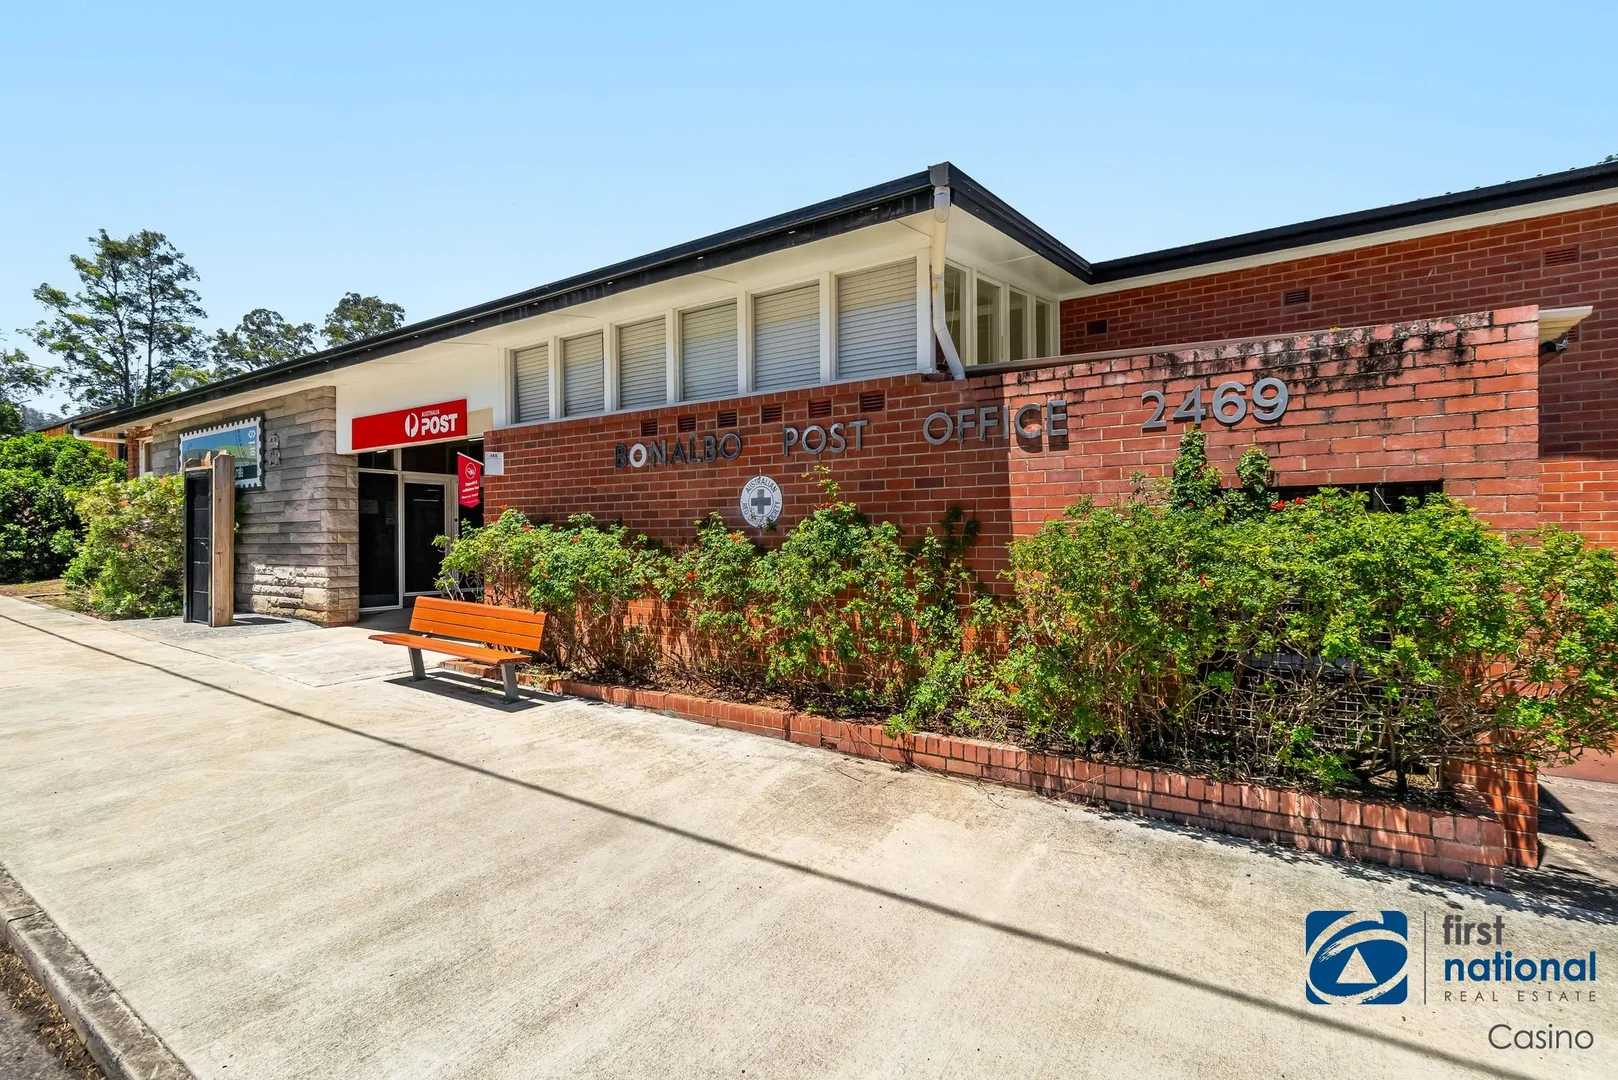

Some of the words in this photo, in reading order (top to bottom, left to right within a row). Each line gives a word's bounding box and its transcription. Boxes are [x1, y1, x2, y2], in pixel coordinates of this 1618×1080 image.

[421, 413, 458, 436] POST
[615, 432, 742, 469] BONALBO
[783, 419, 868, 457] POST
[922, 400, 1068, 446] OFFICE
[1141, 377, 1289, 429] 2469
[745, 477, 778, 493] AUSTRALIAN
